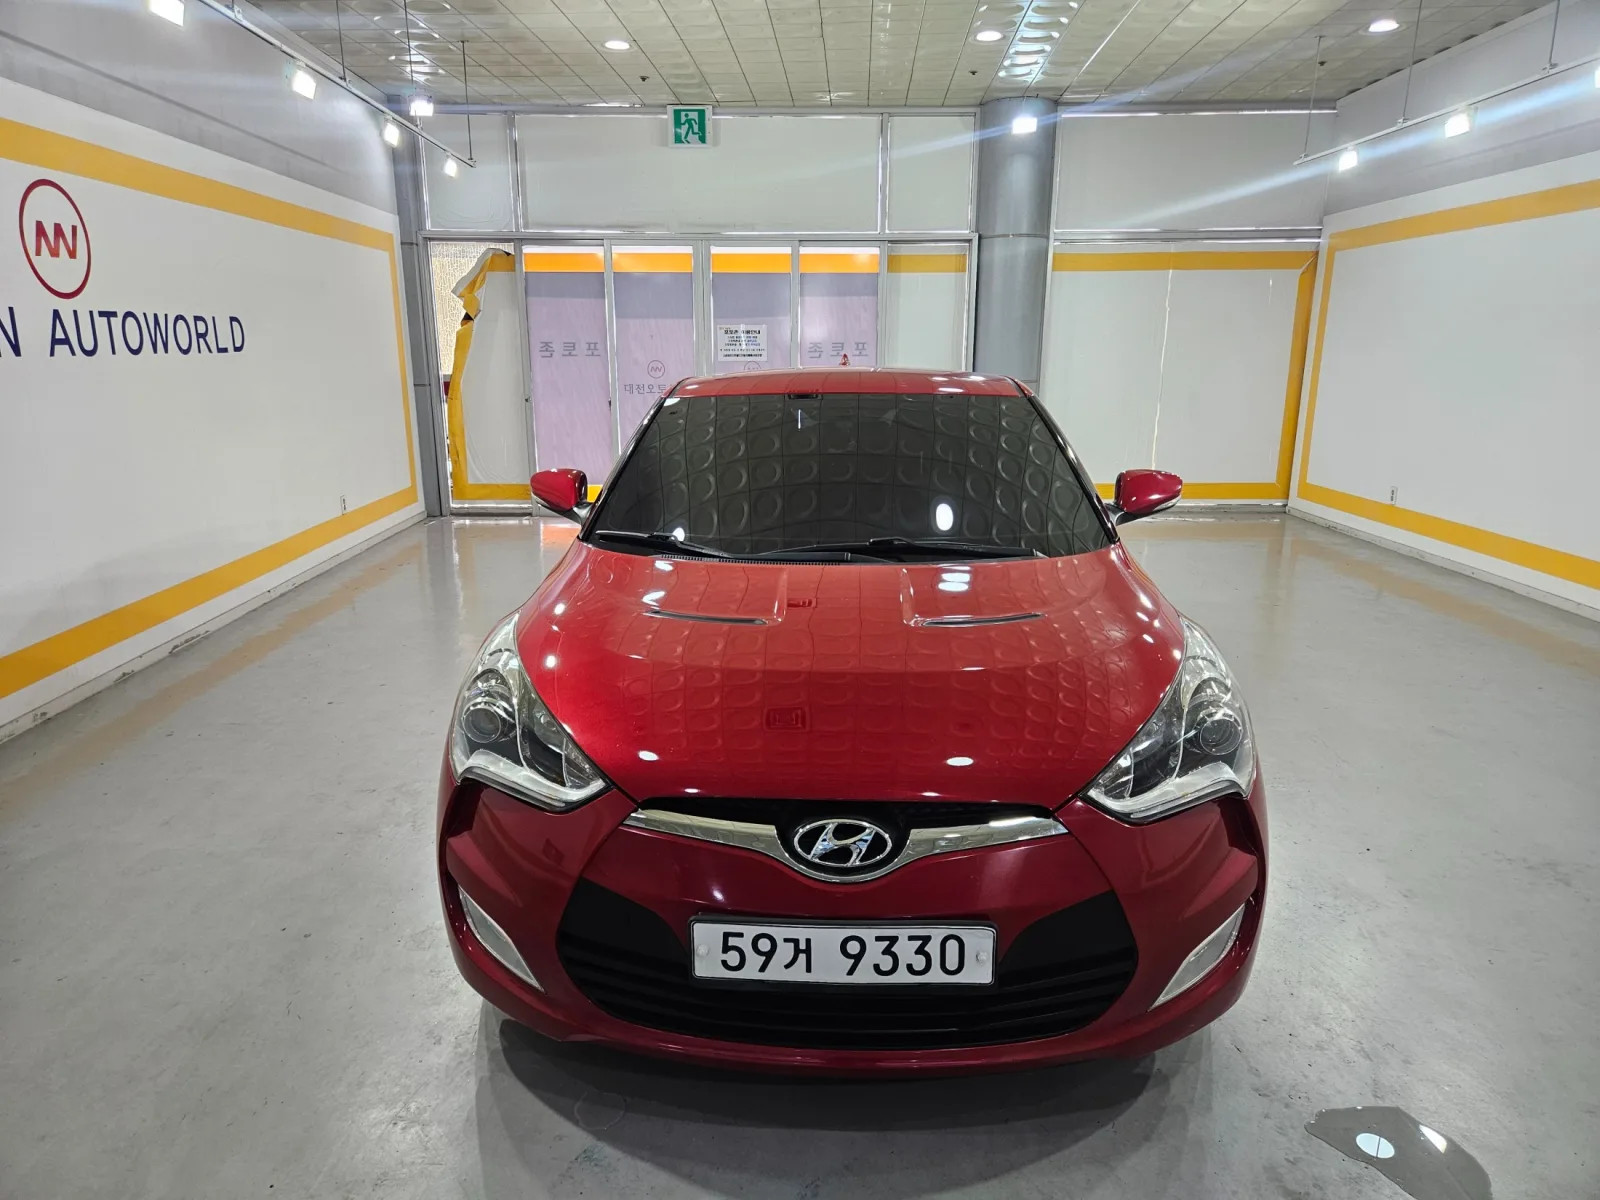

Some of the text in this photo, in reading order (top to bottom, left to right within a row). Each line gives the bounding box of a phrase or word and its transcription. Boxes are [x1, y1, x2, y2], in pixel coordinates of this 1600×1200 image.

[49, 308, 246, 358] AUTOWORLD
[623, 383, 675, 395] 대전오토
[720, 931, 966, 977] 59거 9330
